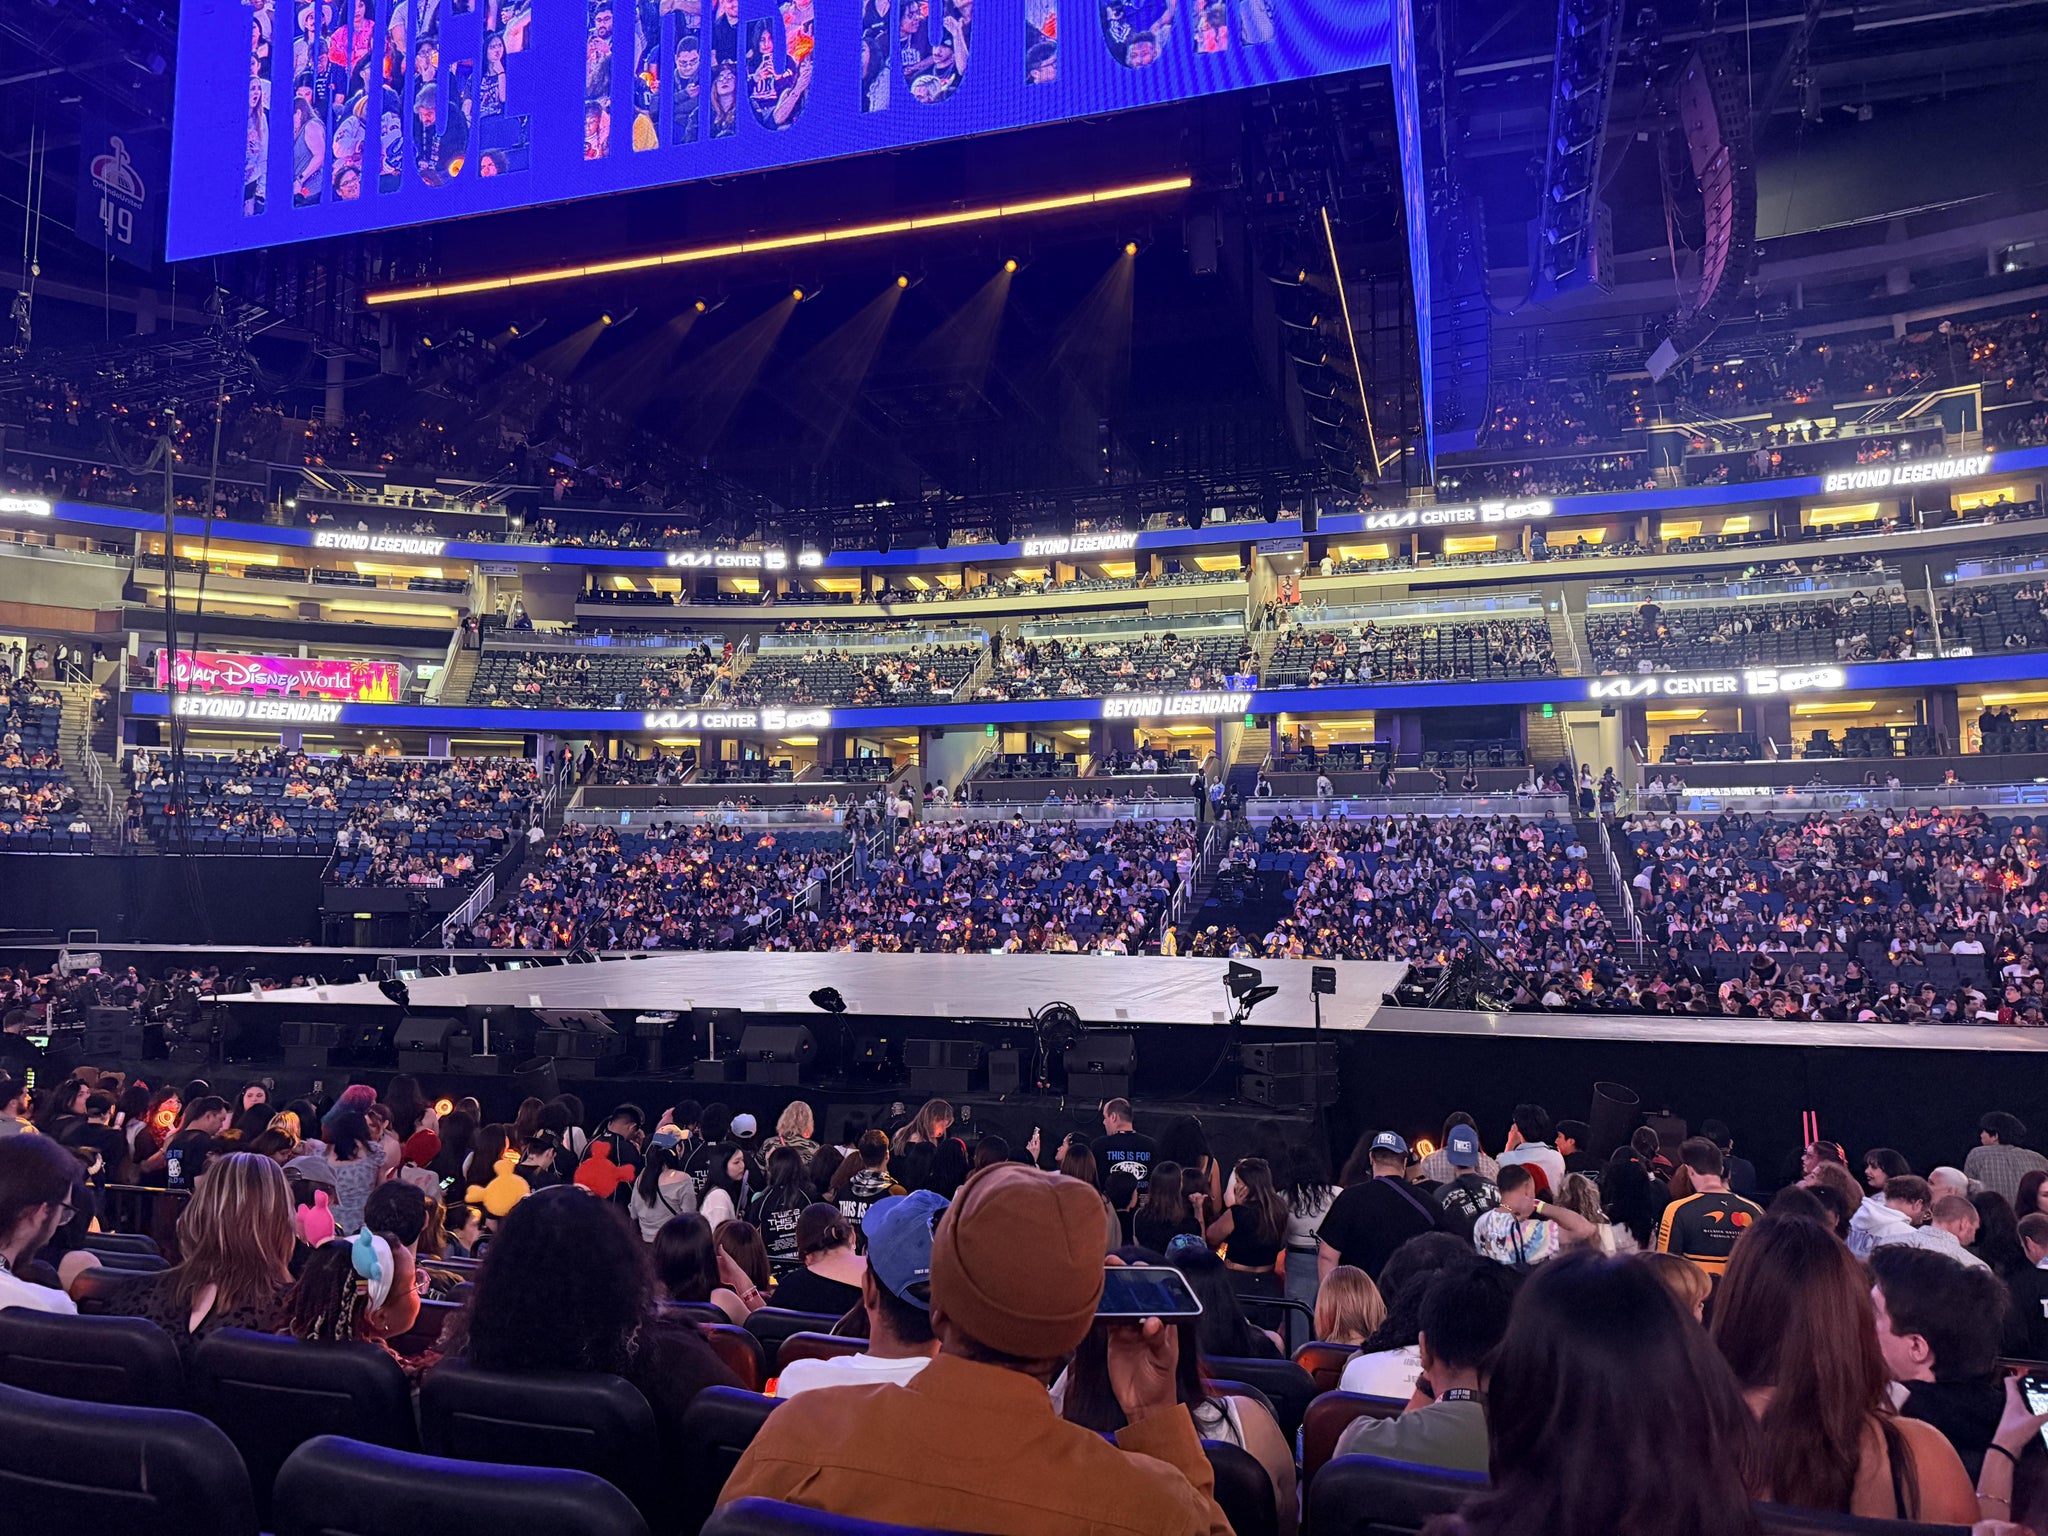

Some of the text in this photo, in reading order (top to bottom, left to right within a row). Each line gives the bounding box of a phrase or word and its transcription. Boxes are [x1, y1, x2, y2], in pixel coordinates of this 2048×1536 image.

[99, 198, 133, 245] 49
[1825, 455, 1992, 492] BEYOND LEGENDARY
[1421, 509, 1475, 524] CENTER
[1480, 503, 1504, 522] 15
[316, 532, 446, 555] BEYOND LEGENDARY
[1023, 533, 1138, 556] BEYOND LEGENDARY
[715, 555, 761, 567] CENTER
[764, 552, 786, 569] 15
[299, 670, 353, 689] World
[1664, 677, 1738, 695] CENTER
[1744, 670, 1778, 695] 15
[178, 697, 342, 722] BEYOND LEGENDARY
[1103, 694, 1251, 717] BEYOND LEGENDARY
[702, 713, 757, 728] CENTER
[761, 710, 787, 730] 15
[1106, 1151, 1151, 1161] THIS IS FOR
[838, 1200, 868, 1218] THIS IS
[767, 1217, 793, 1226] THIS
